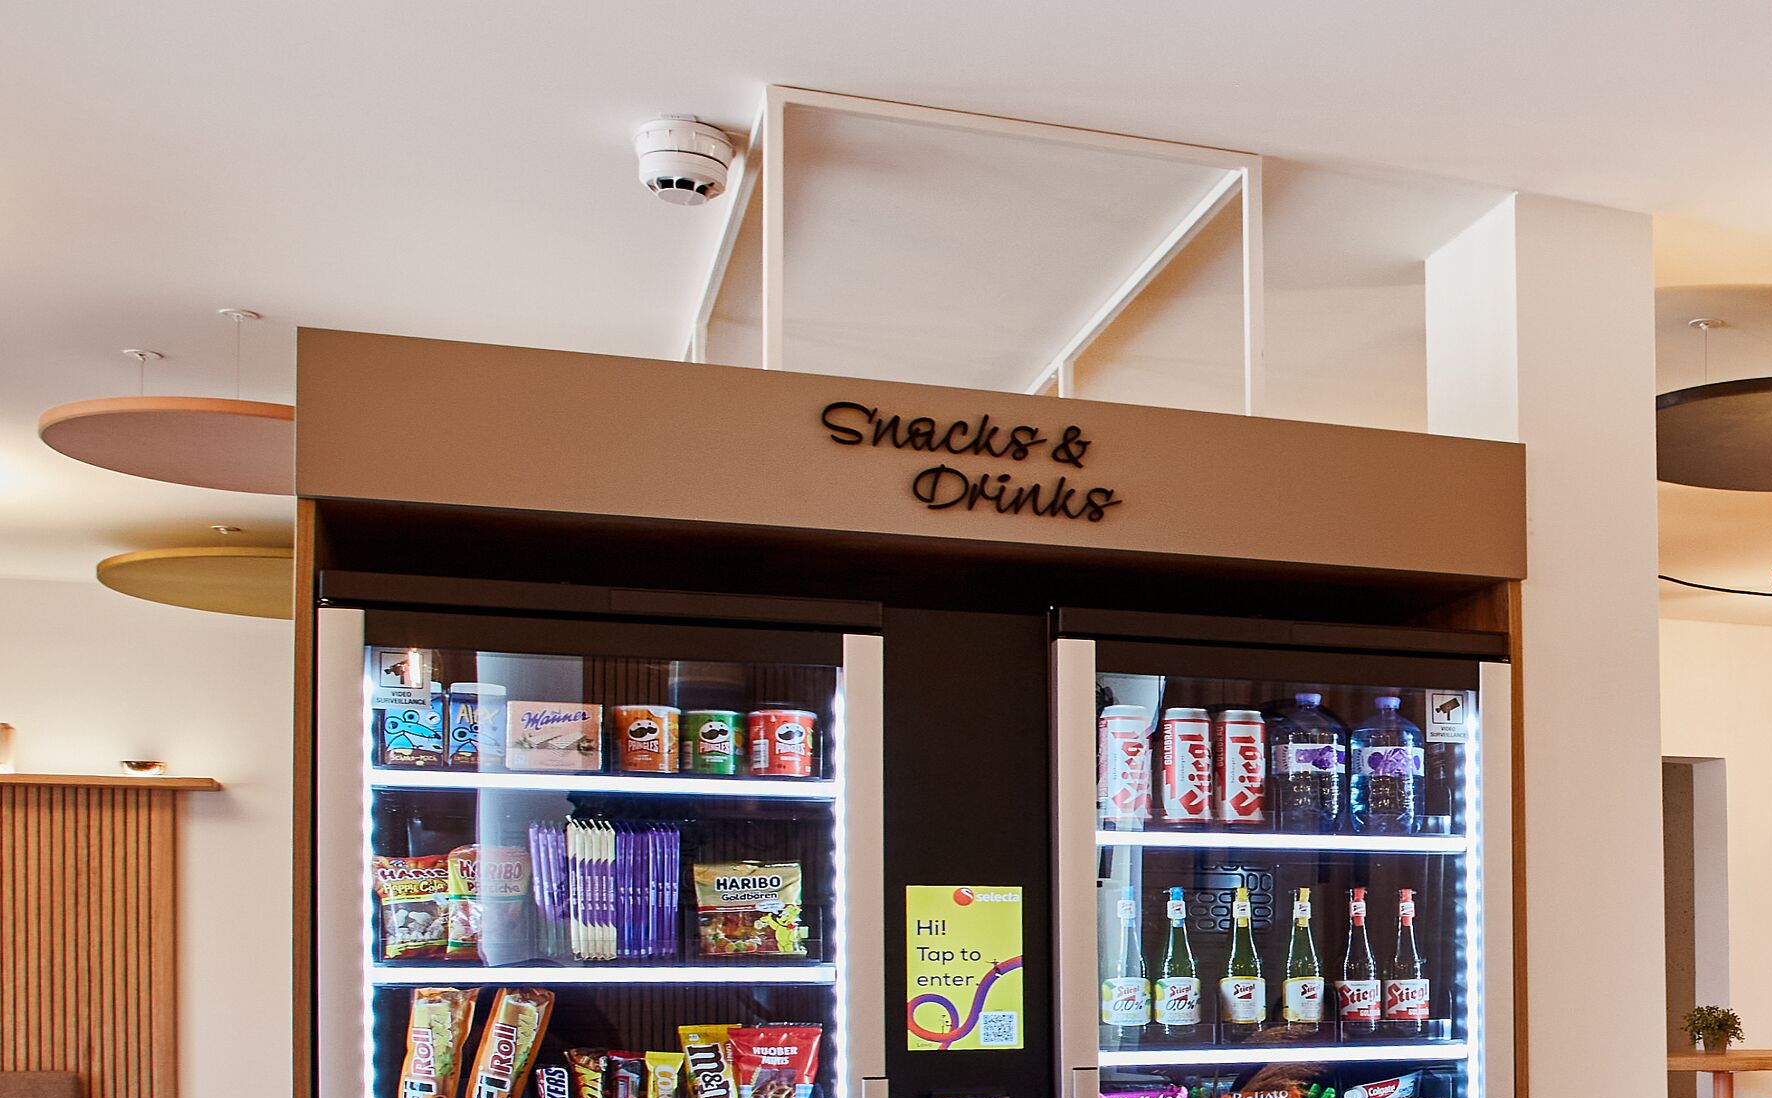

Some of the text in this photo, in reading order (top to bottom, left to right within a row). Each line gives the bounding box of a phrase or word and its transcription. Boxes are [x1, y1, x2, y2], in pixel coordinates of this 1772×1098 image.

[821, 401, 1092, 469] Snacks &
[912, 464, 1123, 523] Drinks
[521, 709, 591, 730] Manner
[628, 739, 660, 753] PRINGLES
[700, 740, 731, 754] PRINGLES
[714, 875, 782, 892] HARIBO
[721, 891, 778, 902] Goldbären
[975, 892, 1021, 903] selecta
[916, 919, 947, 936] Hi!
[916, 946, 982, 964] Tap to
[916, 973, 980, 987] enter.
[1337, 984, 1380, 1009] Stiegl
[1387, 982, 1428, 1010] Stiegl
[411, 1027, 437, 1078] Roll
[488, 1023, 519, 1076] Roll
[1367, 1084, 1396, 1098] Colgate
